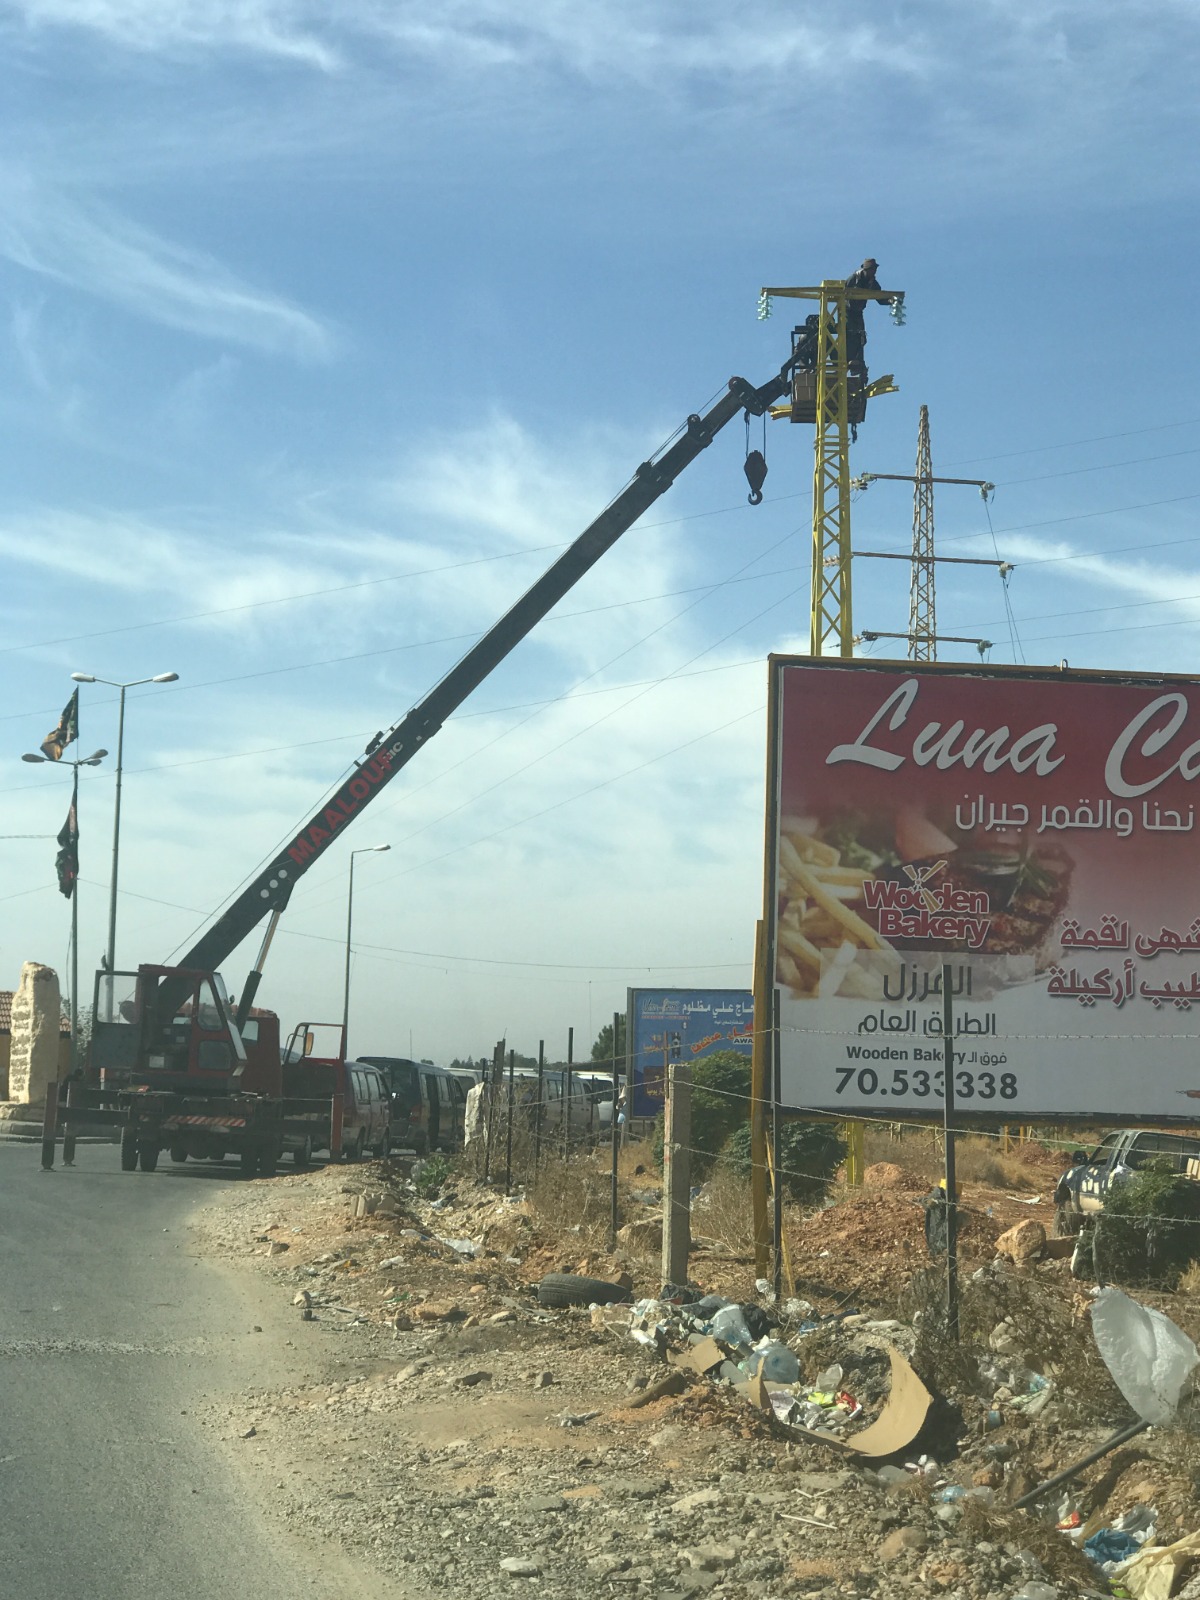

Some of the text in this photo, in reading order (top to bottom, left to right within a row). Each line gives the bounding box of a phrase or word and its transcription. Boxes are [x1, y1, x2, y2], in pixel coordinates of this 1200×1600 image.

[825, 678, 1066, 777] Luna
[955, 794, 1194, 837] نحنا والقمر جيران
[862, 880, 990, 914] Wooden
[878, 907, 991, 948] Bakery
[1060, 913, 1130, 950] لقمة
[1047, 957, 1135, 1007] أركيلة
[858, 1009, 917, 1035] العام
[846, 1046, 909, 1061] Wooden
[913, 1048, 966, 1065] Bakry
[980, 1052, 1007, 1066] فوق
